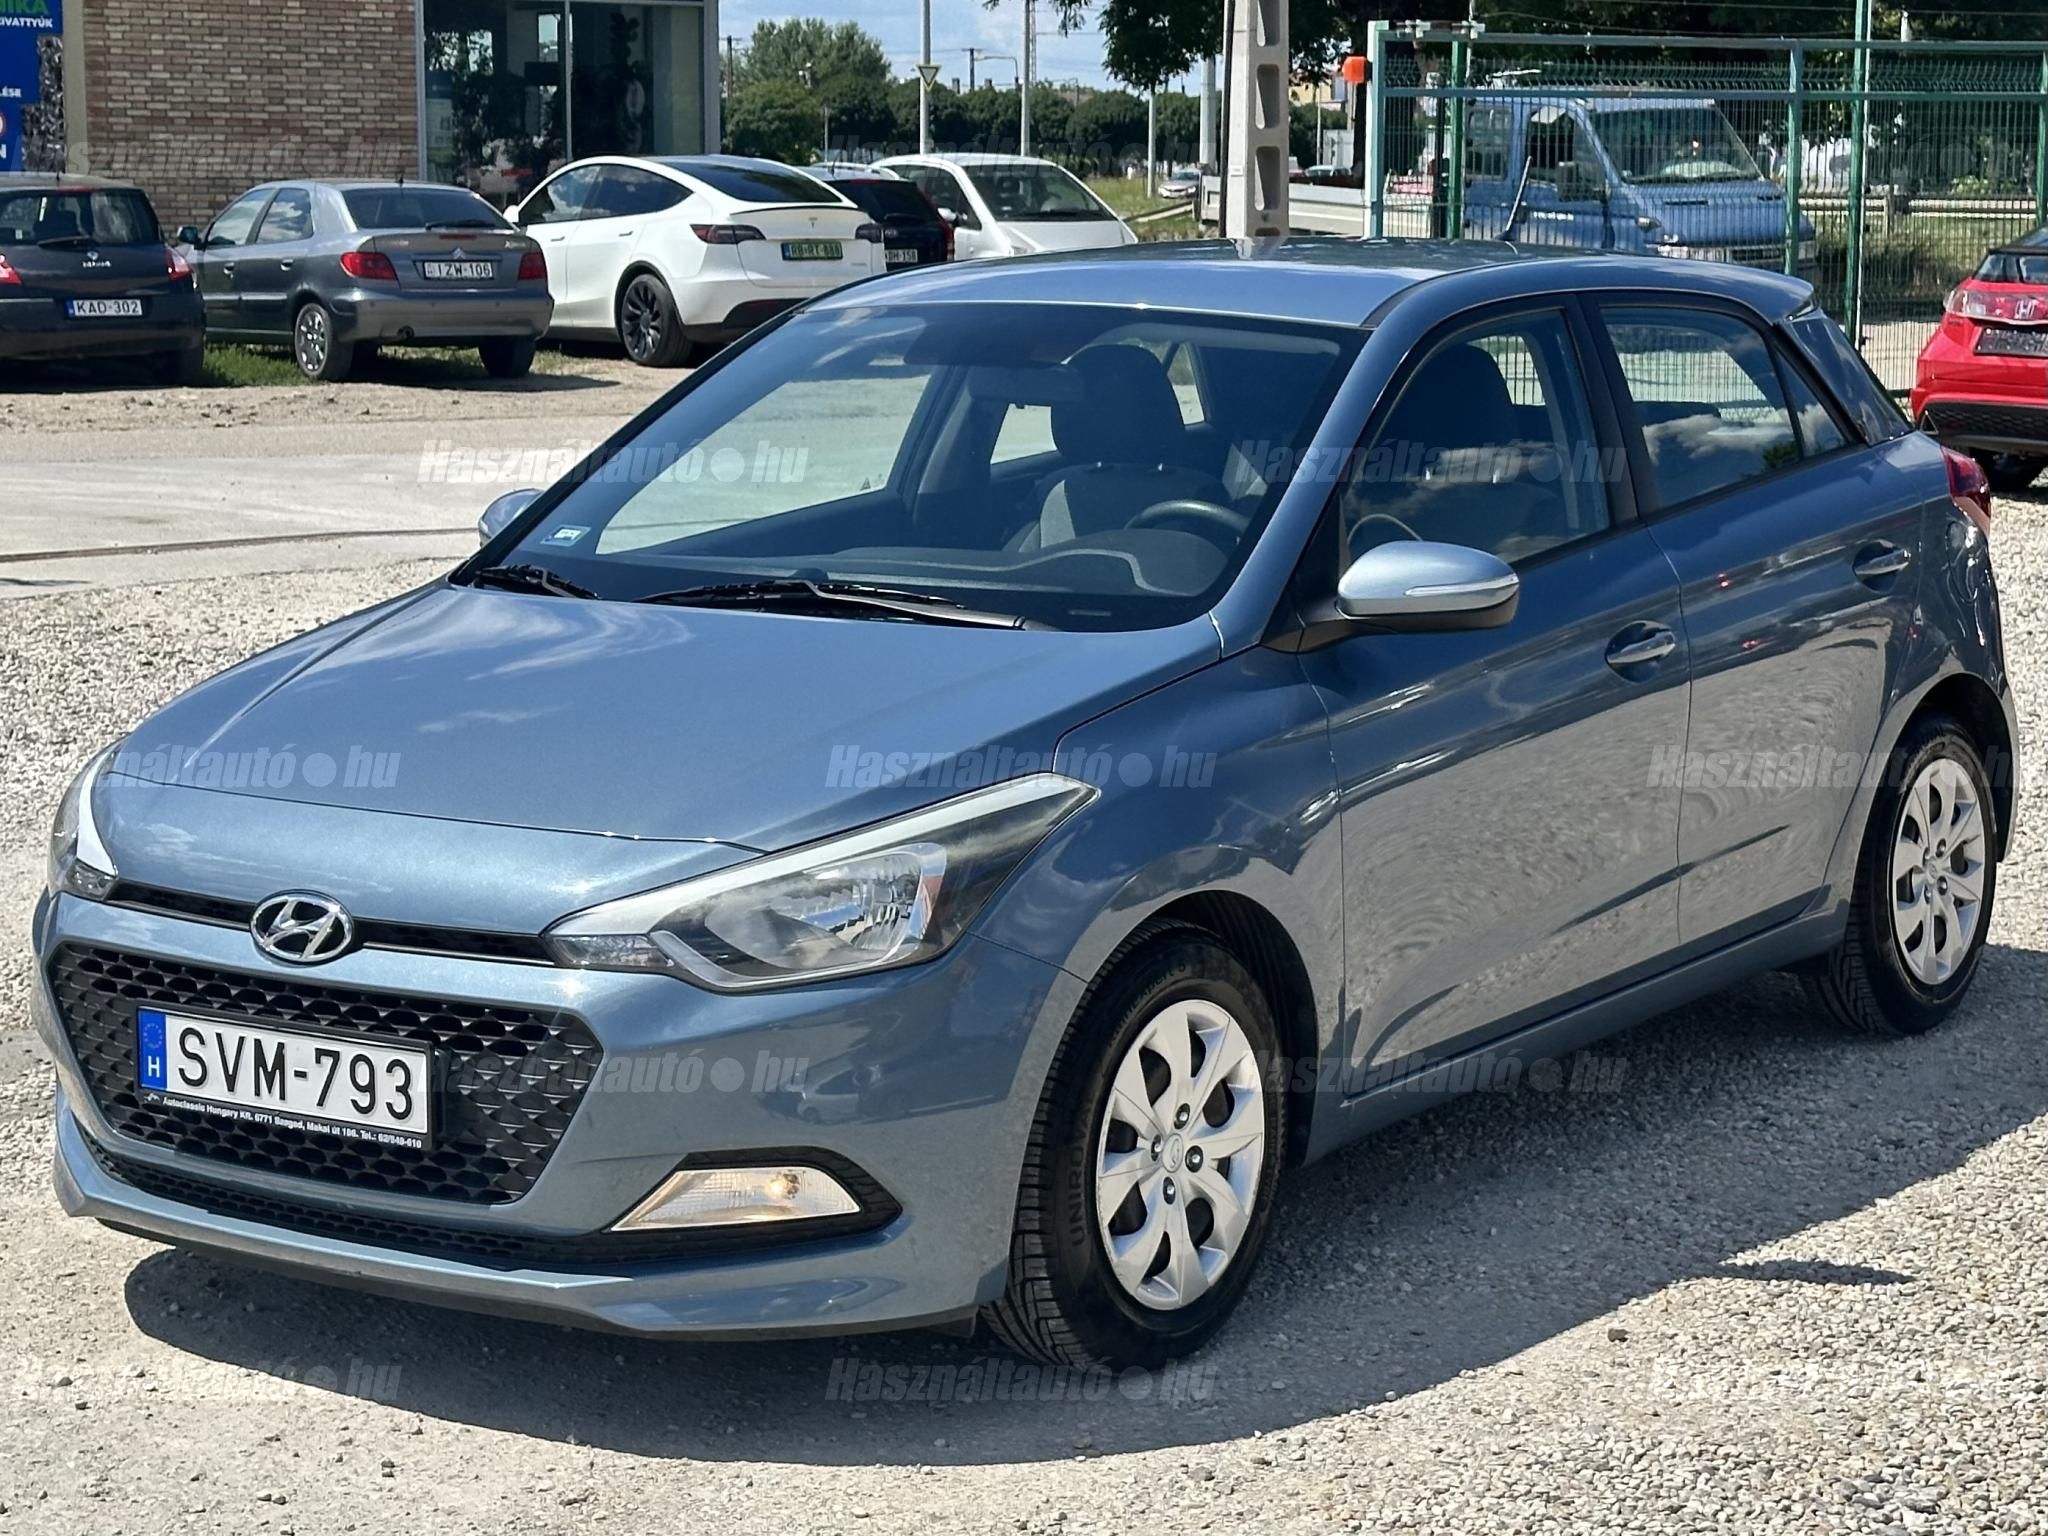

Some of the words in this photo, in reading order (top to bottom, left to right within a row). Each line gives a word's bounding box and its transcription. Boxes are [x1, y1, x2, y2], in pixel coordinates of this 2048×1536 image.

[76, 301, 139, 314] KAD-302
[148, 1056, 160, 1077] H
[178, 1027, 413, 1121] SVM-793
